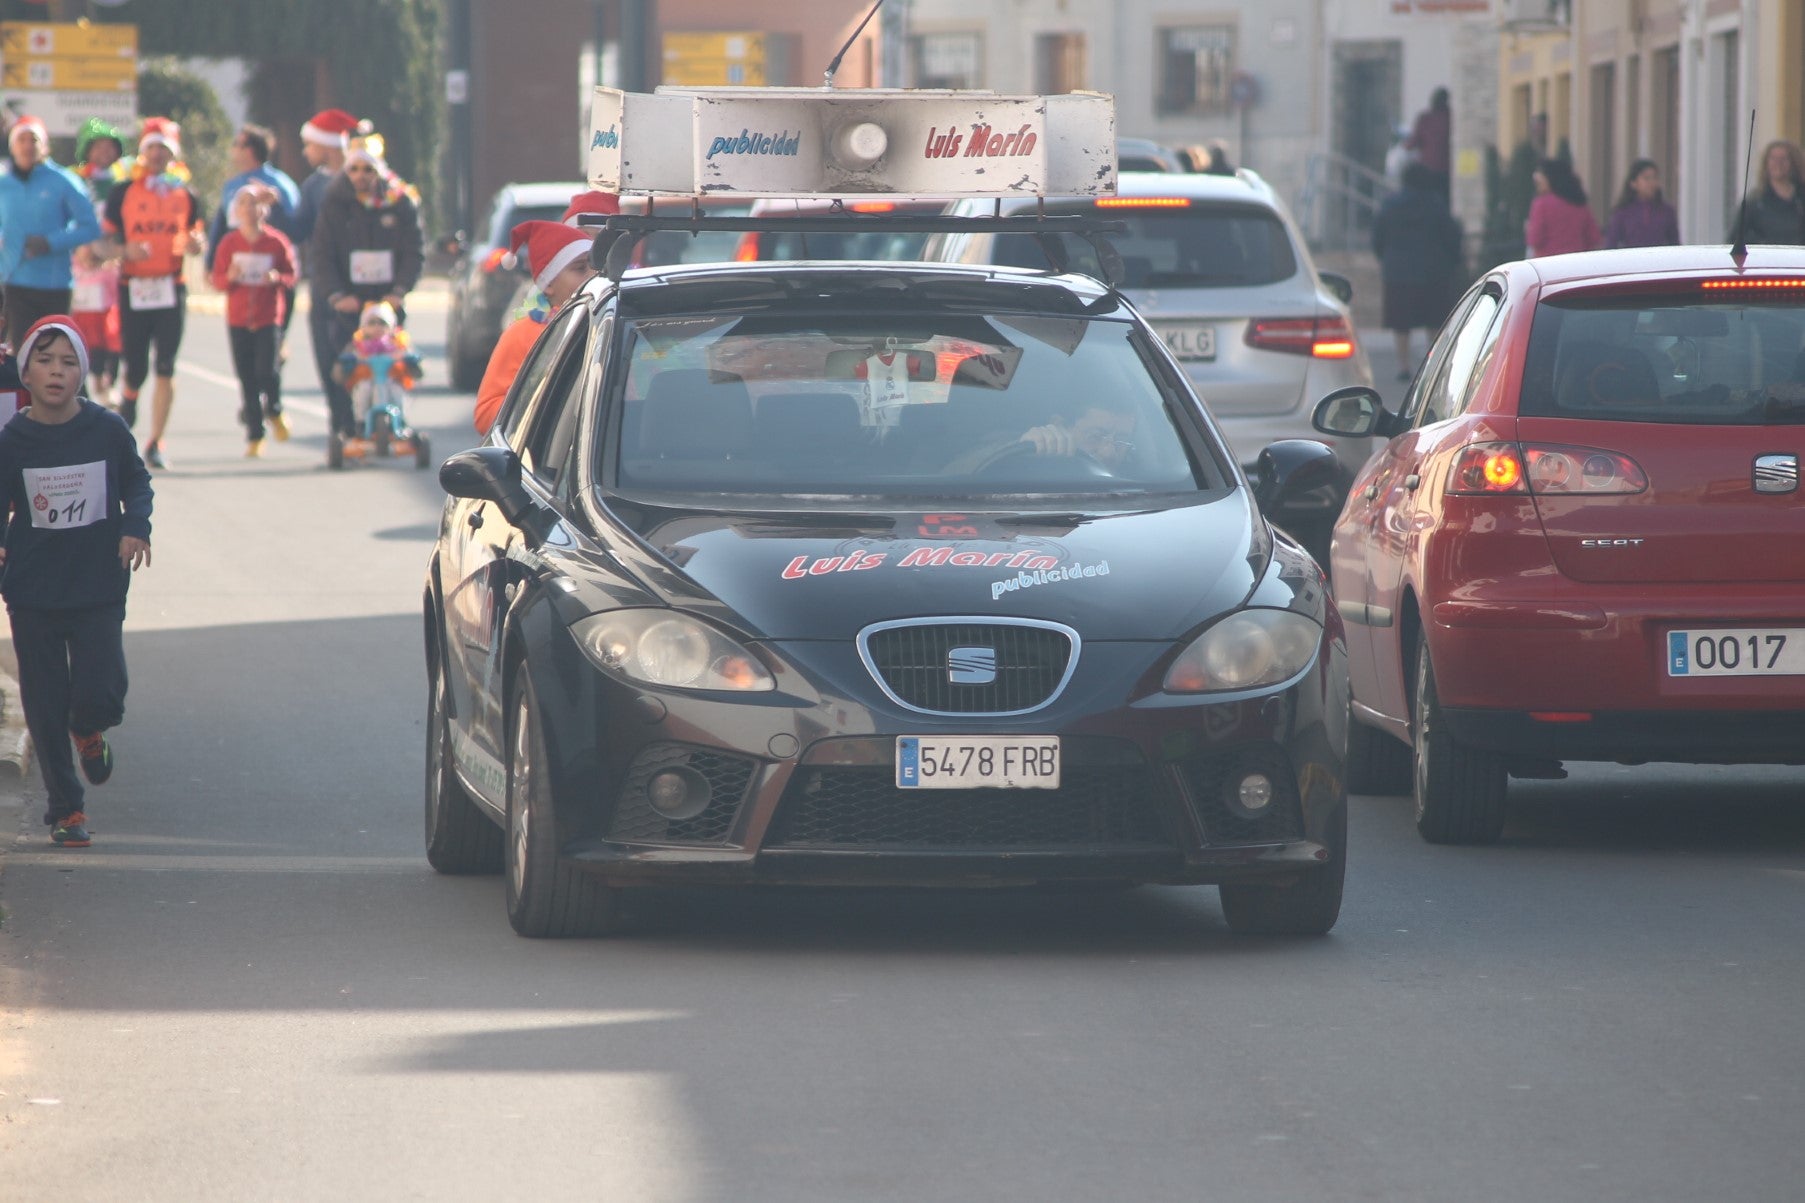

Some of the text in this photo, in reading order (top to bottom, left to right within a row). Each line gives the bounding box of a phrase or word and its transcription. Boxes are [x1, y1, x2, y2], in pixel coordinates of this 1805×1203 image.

[706, 129, 800, 160] publicidad
[924, 124, 1038, 158] Luis Marín
[1165, 331, 1210, 352] KLG
[1581, 539, 1644, 549] SEAT
[781, 546, 1060, 580] Luis Marín
[991, 559, 1110, 600] publicidad
[1675, 635, 1787, 669] E 0017
[904, 746, 1056, 778] E 5478 FRB
